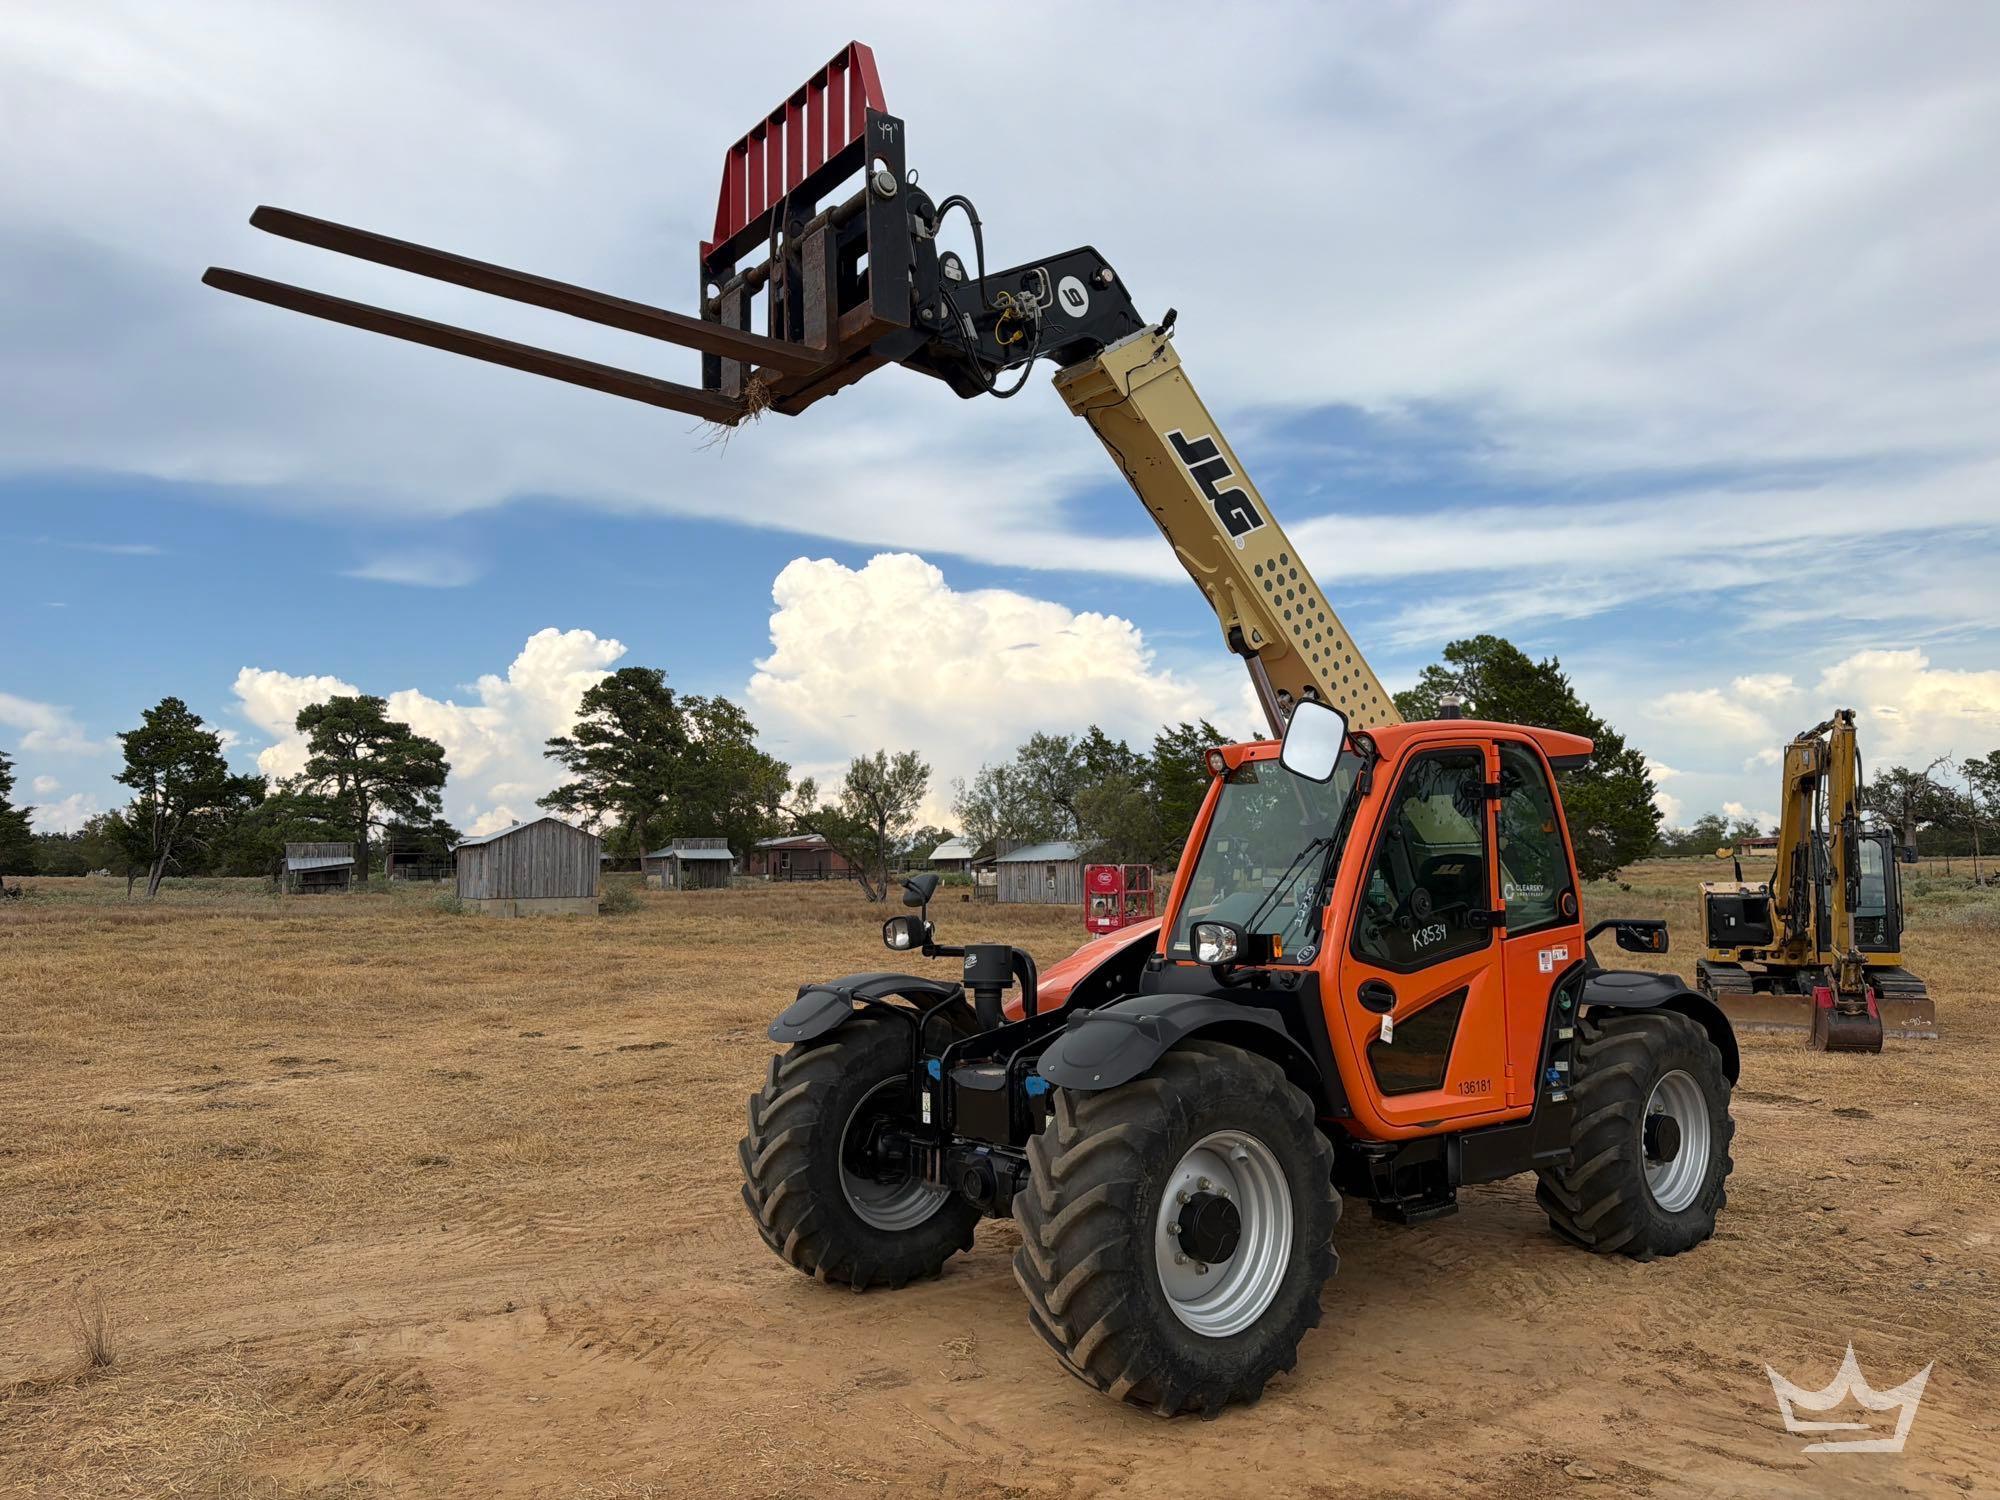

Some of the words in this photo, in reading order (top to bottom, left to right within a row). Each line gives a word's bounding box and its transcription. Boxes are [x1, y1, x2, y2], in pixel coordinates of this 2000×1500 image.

[1165, 429, 1266, 539] JLG
[1411, 923, 1447, 952] K8534
[1458, 1079, 1491, 1096] 136181
